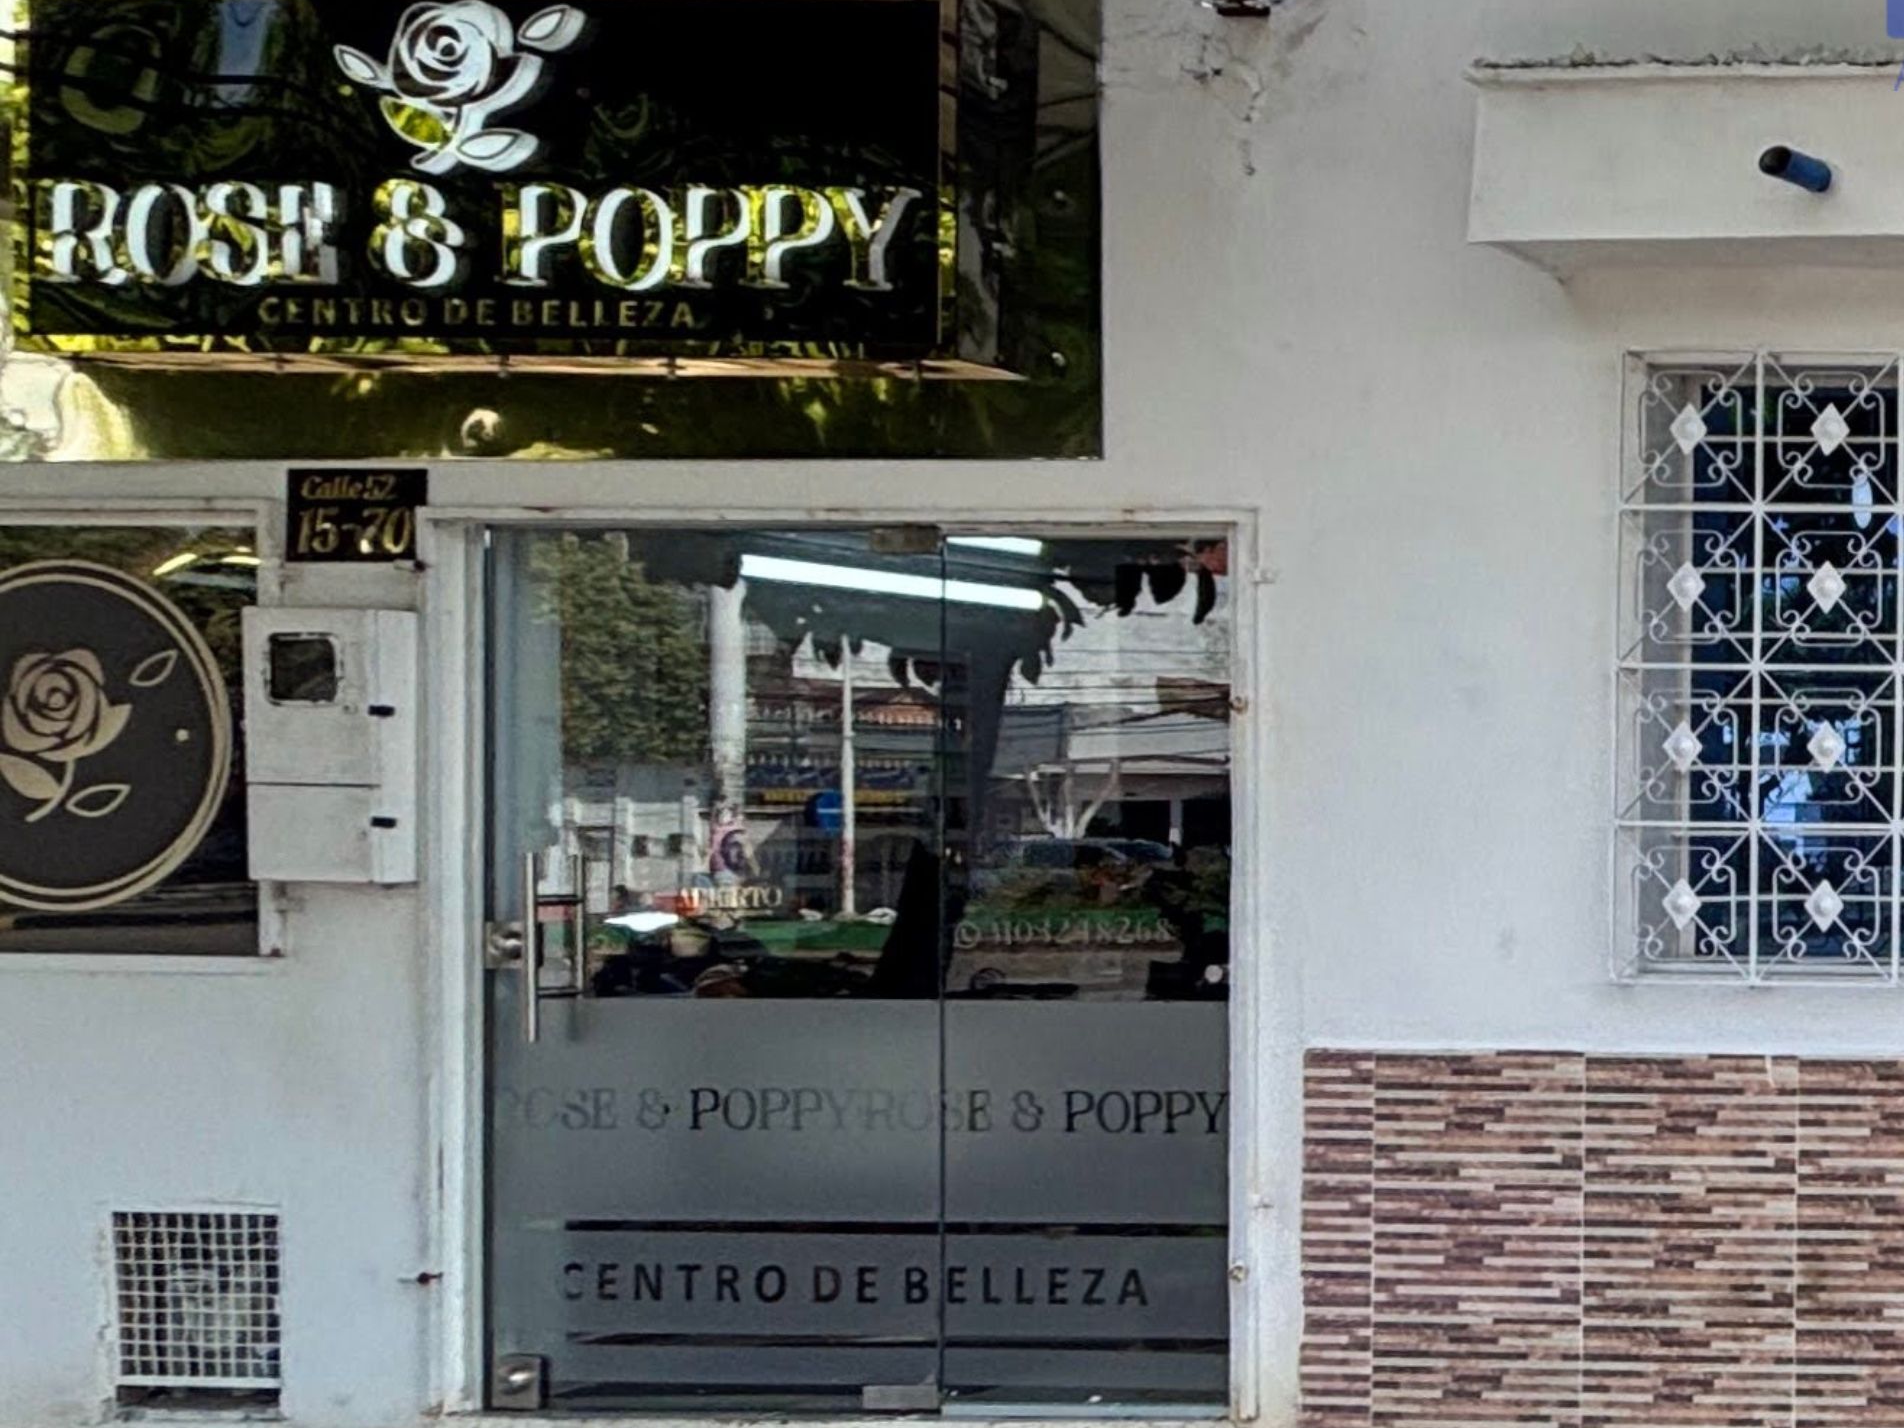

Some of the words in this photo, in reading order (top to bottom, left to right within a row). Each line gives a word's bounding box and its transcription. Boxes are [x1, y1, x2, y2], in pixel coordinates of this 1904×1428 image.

[32, 178, 338, 287] ROSE
[370, 178, 464, 288] &
[495, 182, 922, 292] POPPY
[257, 296, 427, 327] CENTRO
[443, 298, 498, 327] DE
[511, 299, 698, 329] BELLEZA
[301, 475, 364, 500] Calle
[363, 473, 398, 500] 52
[297, 505, 412, 555] 15-70
[1011, 1089, 1045, 1133] &
[1064, 1089, 1229, 1134] POPPY
[557, 1262, 788, 1303] CENTRO
[812, 1264, 880, 1304] DE
[904, 1266, 1149, 1307] BELLEZA
